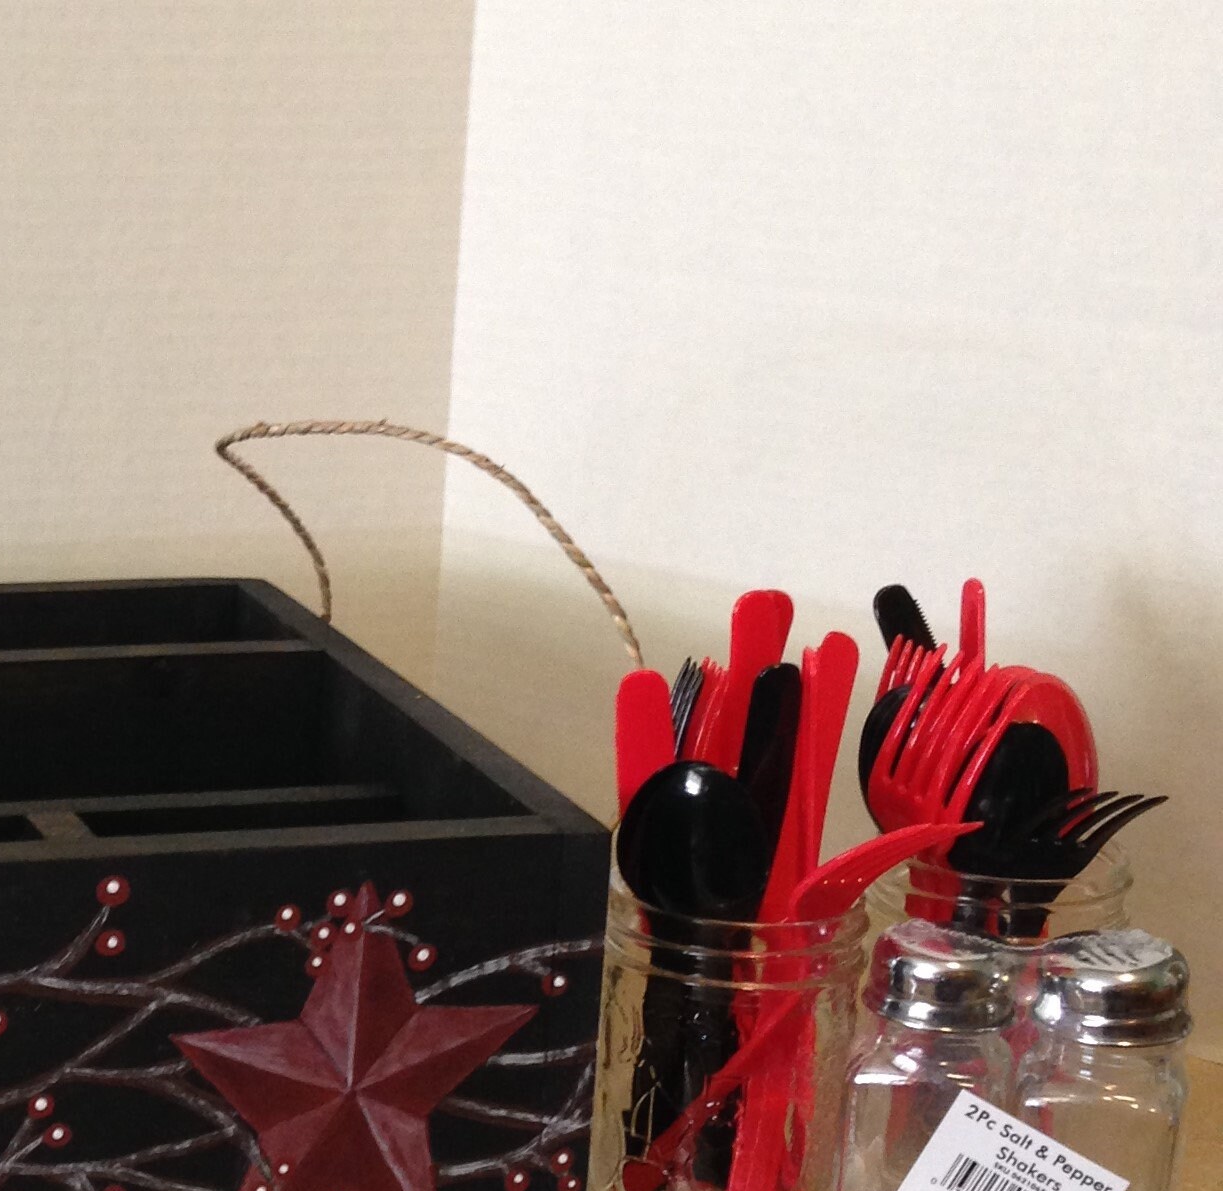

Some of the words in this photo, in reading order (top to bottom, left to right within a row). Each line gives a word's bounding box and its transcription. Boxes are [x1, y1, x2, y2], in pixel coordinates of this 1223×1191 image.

[964, 1104, 996, 1130] 2Pc
[999, 1124, 1033, 1150] Salt
[1035, 1145, 1049, 1161] &
[996, 1146, 1062, 1191] Shakers
